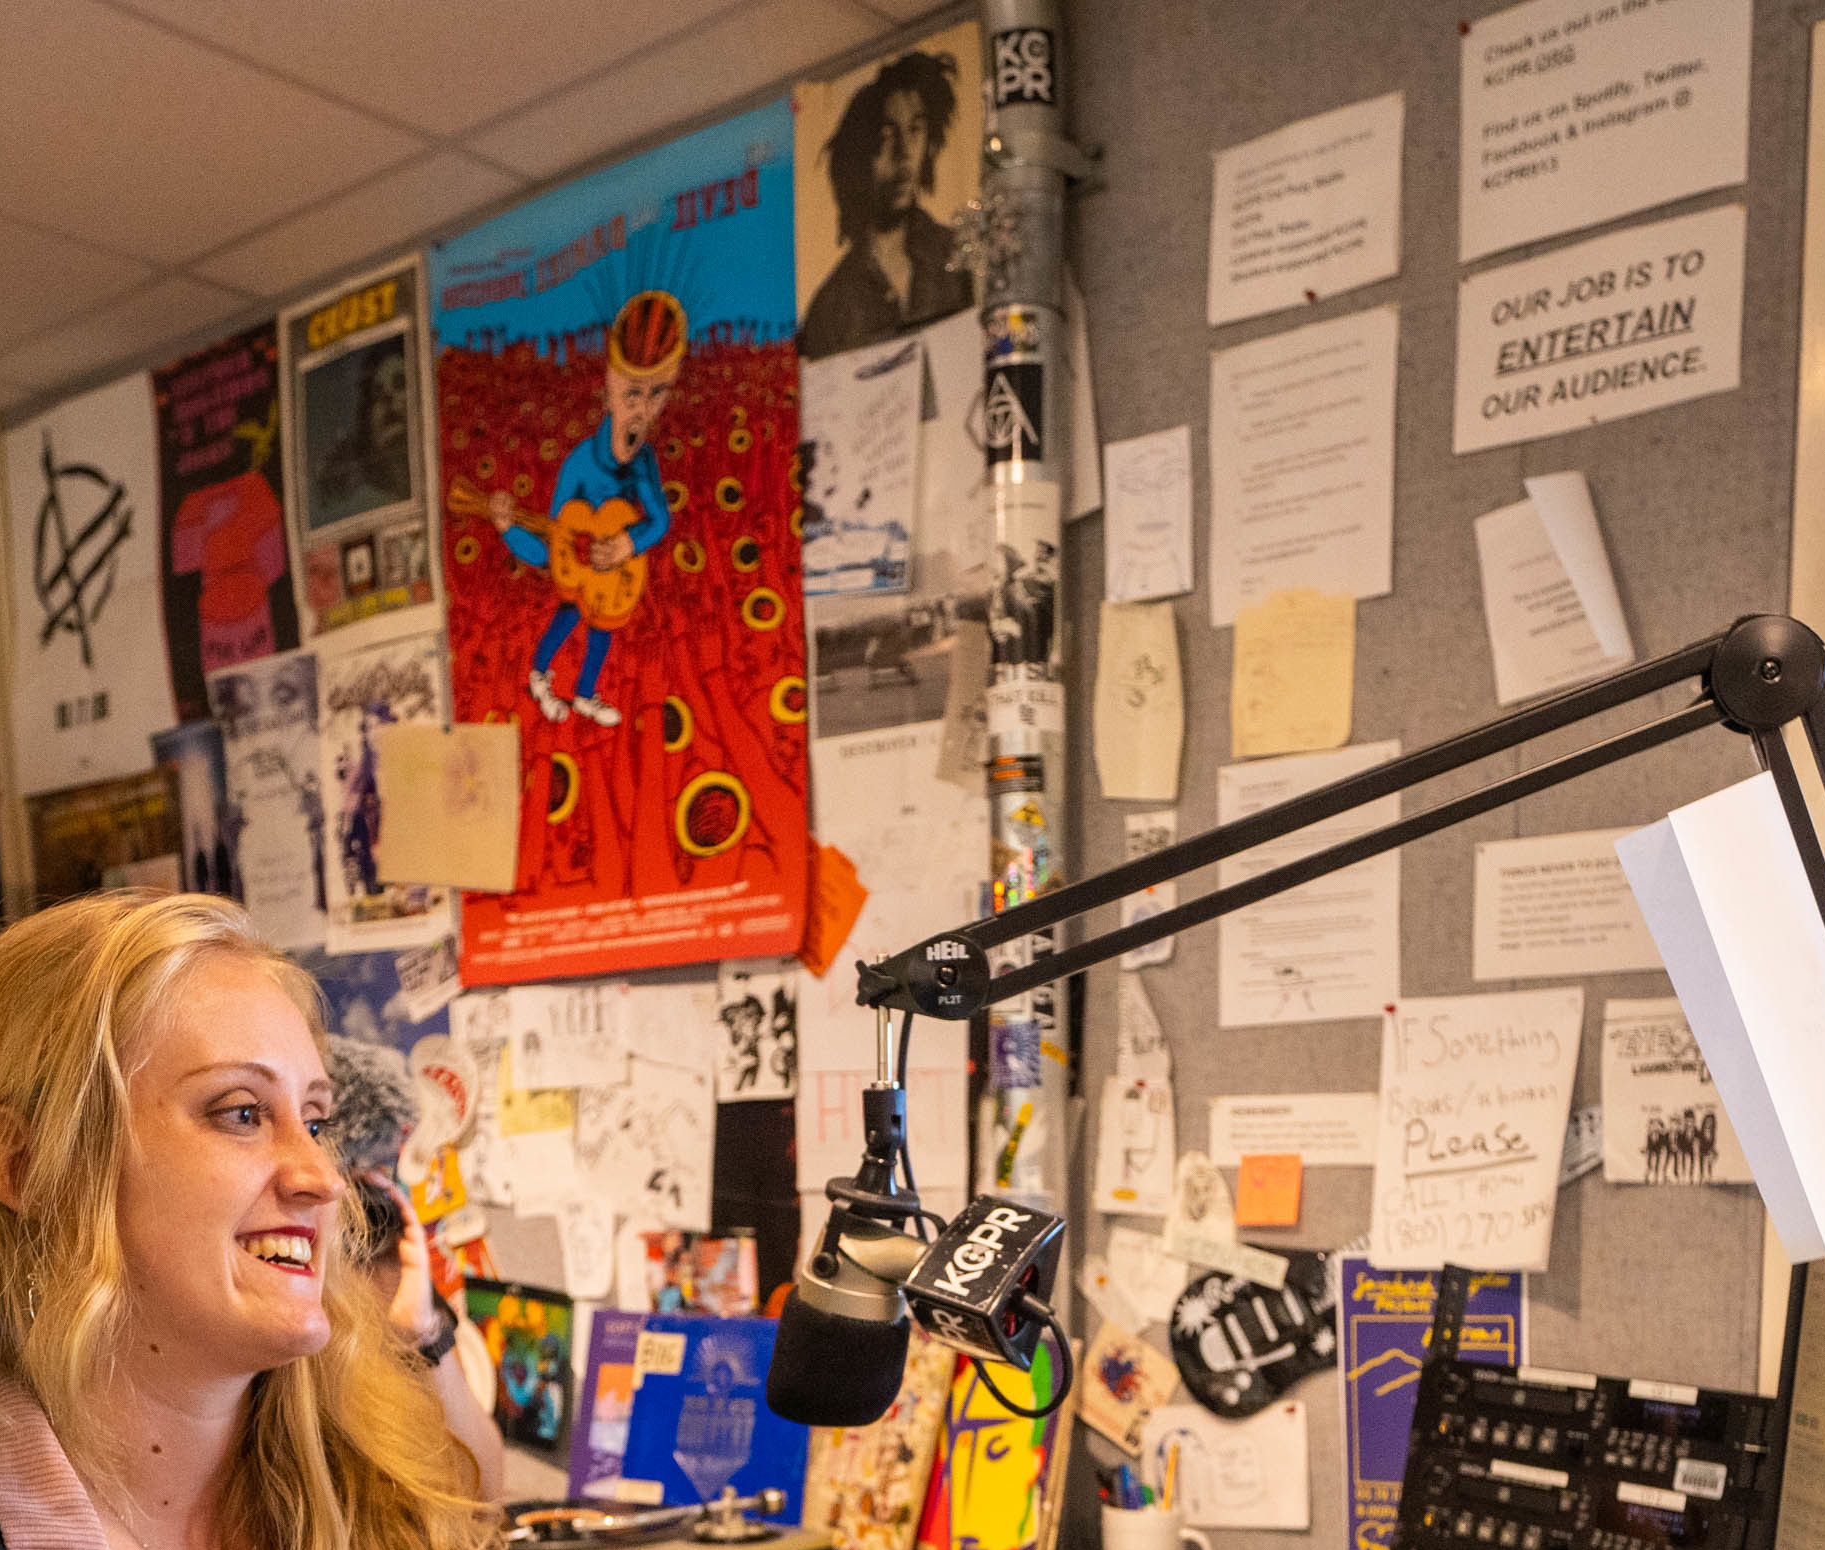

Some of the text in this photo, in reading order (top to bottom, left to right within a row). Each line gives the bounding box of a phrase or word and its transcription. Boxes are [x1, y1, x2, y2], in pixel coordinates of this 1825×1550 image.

[1491, 248, 1706, 328] OUR JOB IS TO
[1495, 296, 1698, 374] ENTERTAIN
[1480, 345, 1707, 421] OUR AUDIENCE.
[932, 1204, 1034, 1298] KCPR
